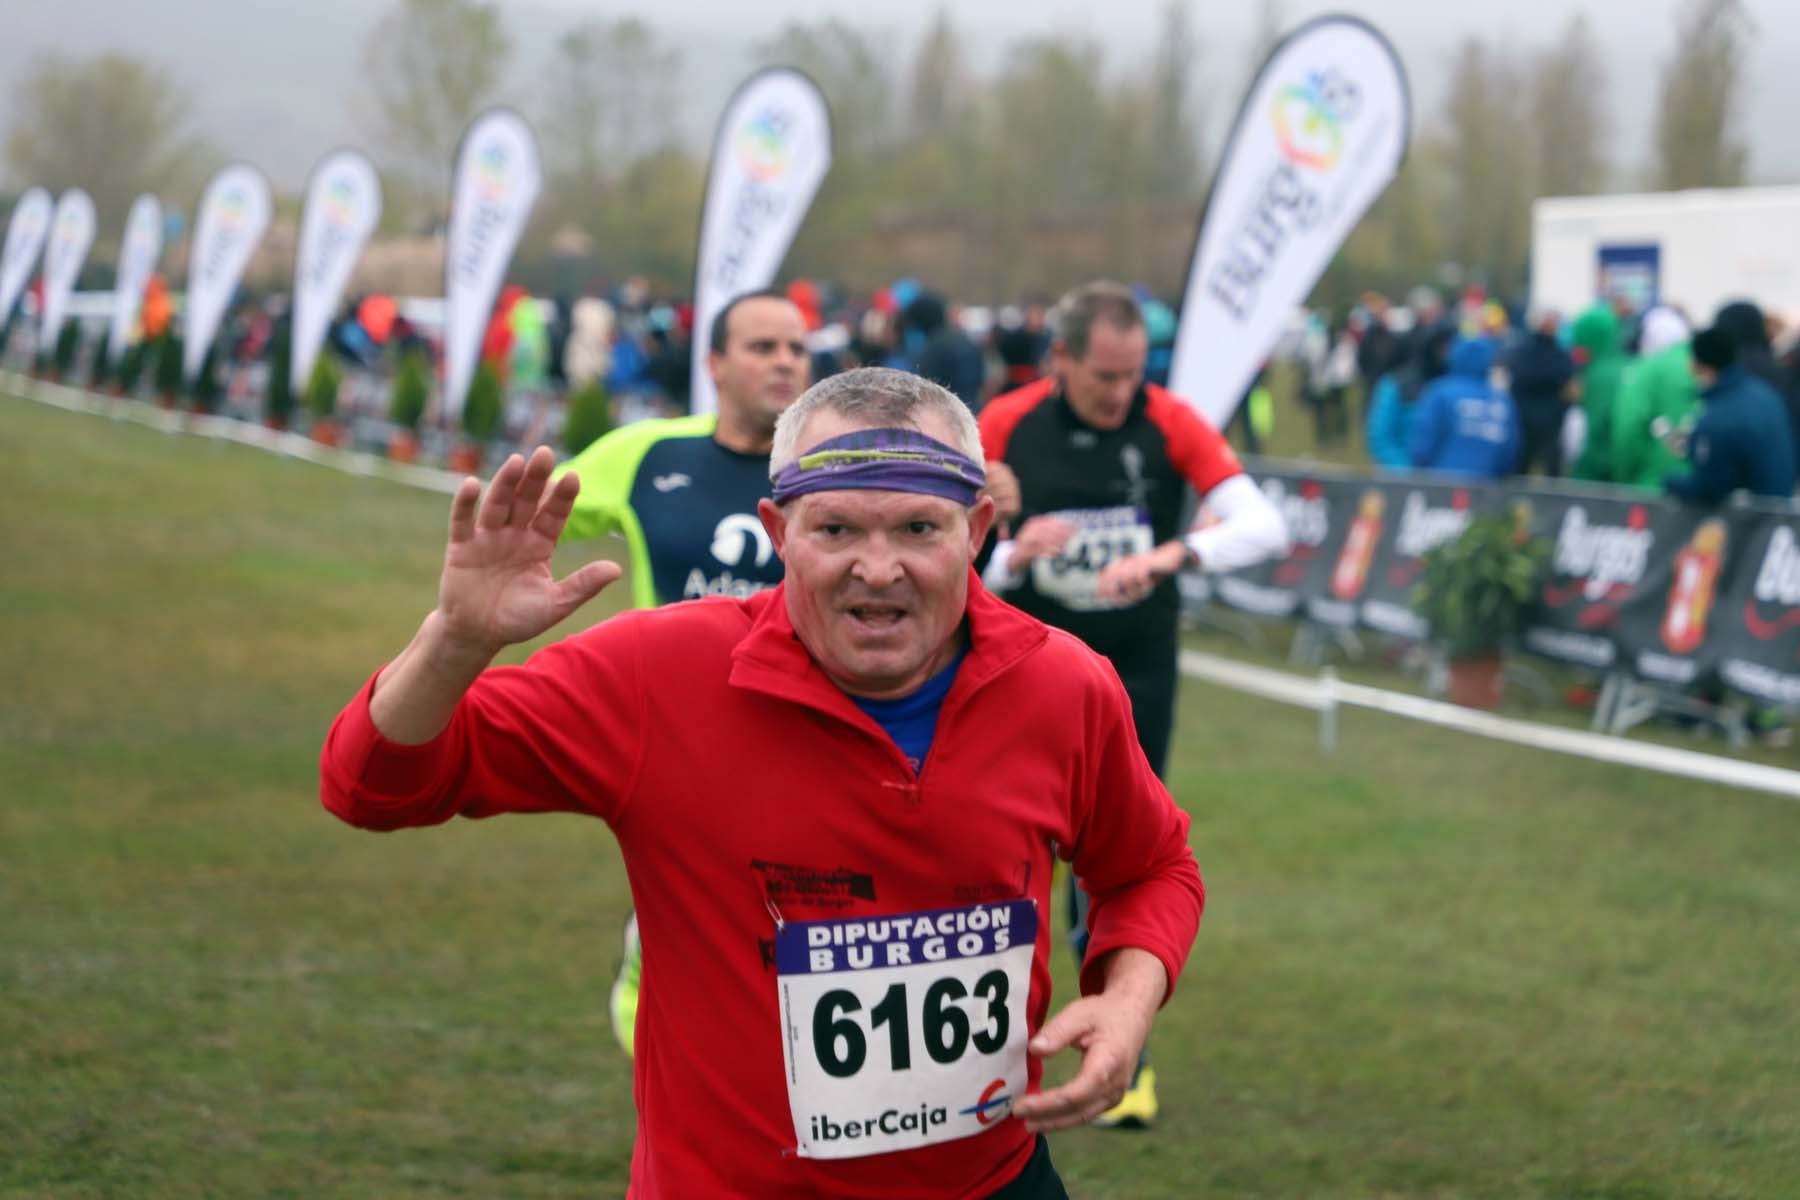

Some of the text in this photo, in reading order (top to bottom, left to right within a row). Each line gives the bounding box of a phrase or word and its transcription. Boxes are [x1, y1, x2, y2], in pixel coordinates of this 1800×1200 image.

[808, 905, 1011, 948] DIPUTACIÓN
[809, 928, 1010, 973] BURGOS
[812, 968, 1011, 1079] 6163
[811, 1103, 948, 1141] iberCaja
